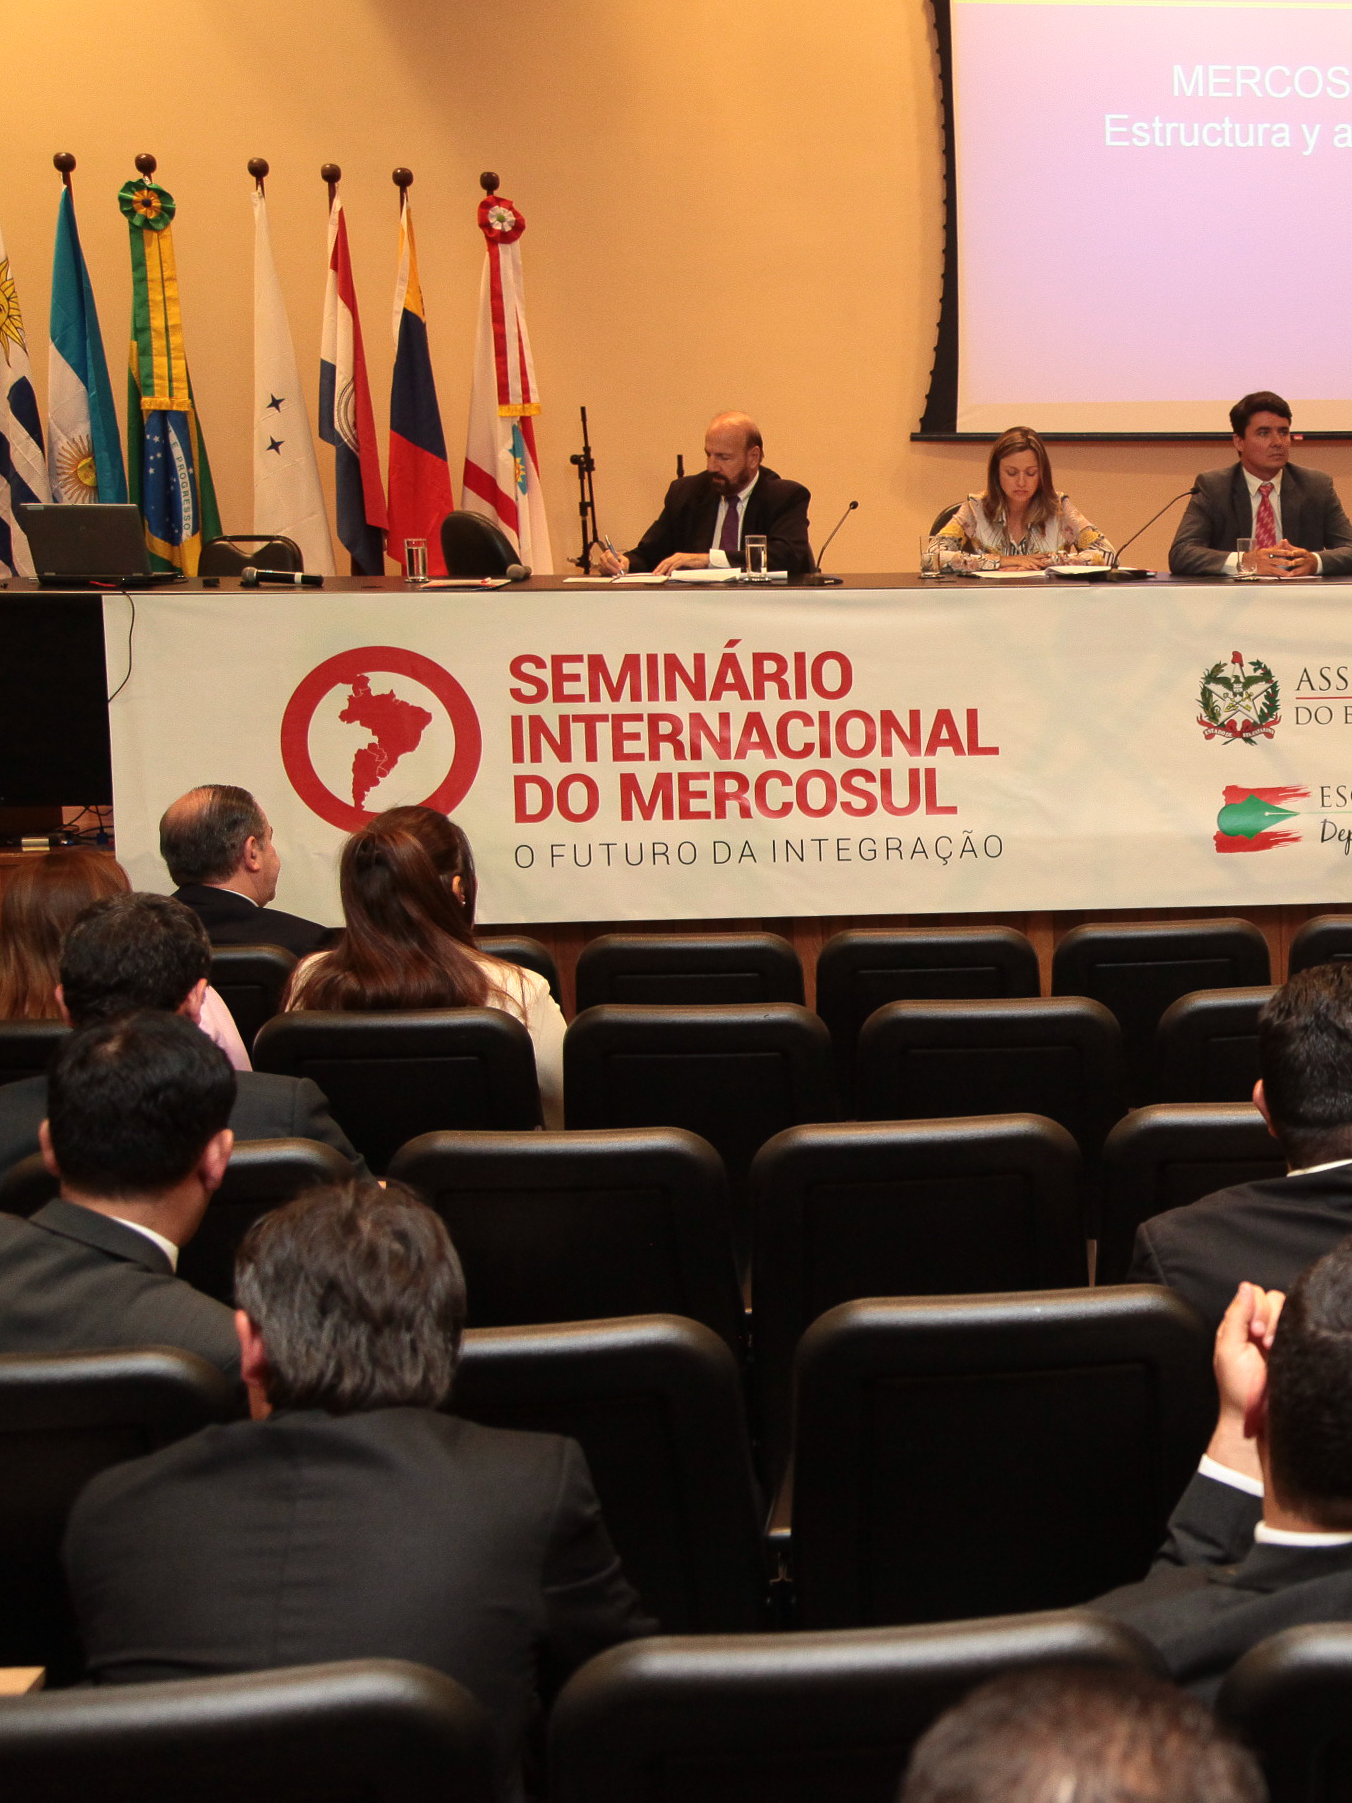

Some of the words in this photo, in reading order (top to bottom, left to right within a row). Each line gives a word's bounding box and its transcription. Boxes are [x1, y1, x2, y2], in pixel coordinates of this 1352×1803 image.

[1104, 113, 1291, 148] Estructura
[1299, 122, 1322, 156] y
[176, 456, 191, 531] PROGRESSO
[508, 638, 854, 705] SEMINÁRIO
[510, 708, 1000, 764] INTERNACIONAL
[1295, 705, 1334, 725] DO
[513, 773, 600, 824] DO
[619, 767, 958, 822] MERCOSUL
[514, 844, 535, 869] O
[550, 841, 698, 868] FUTURO
[712, 839, 758, 865] DA
[772, 829, 1004, 866] INTEGRAÇÃO
